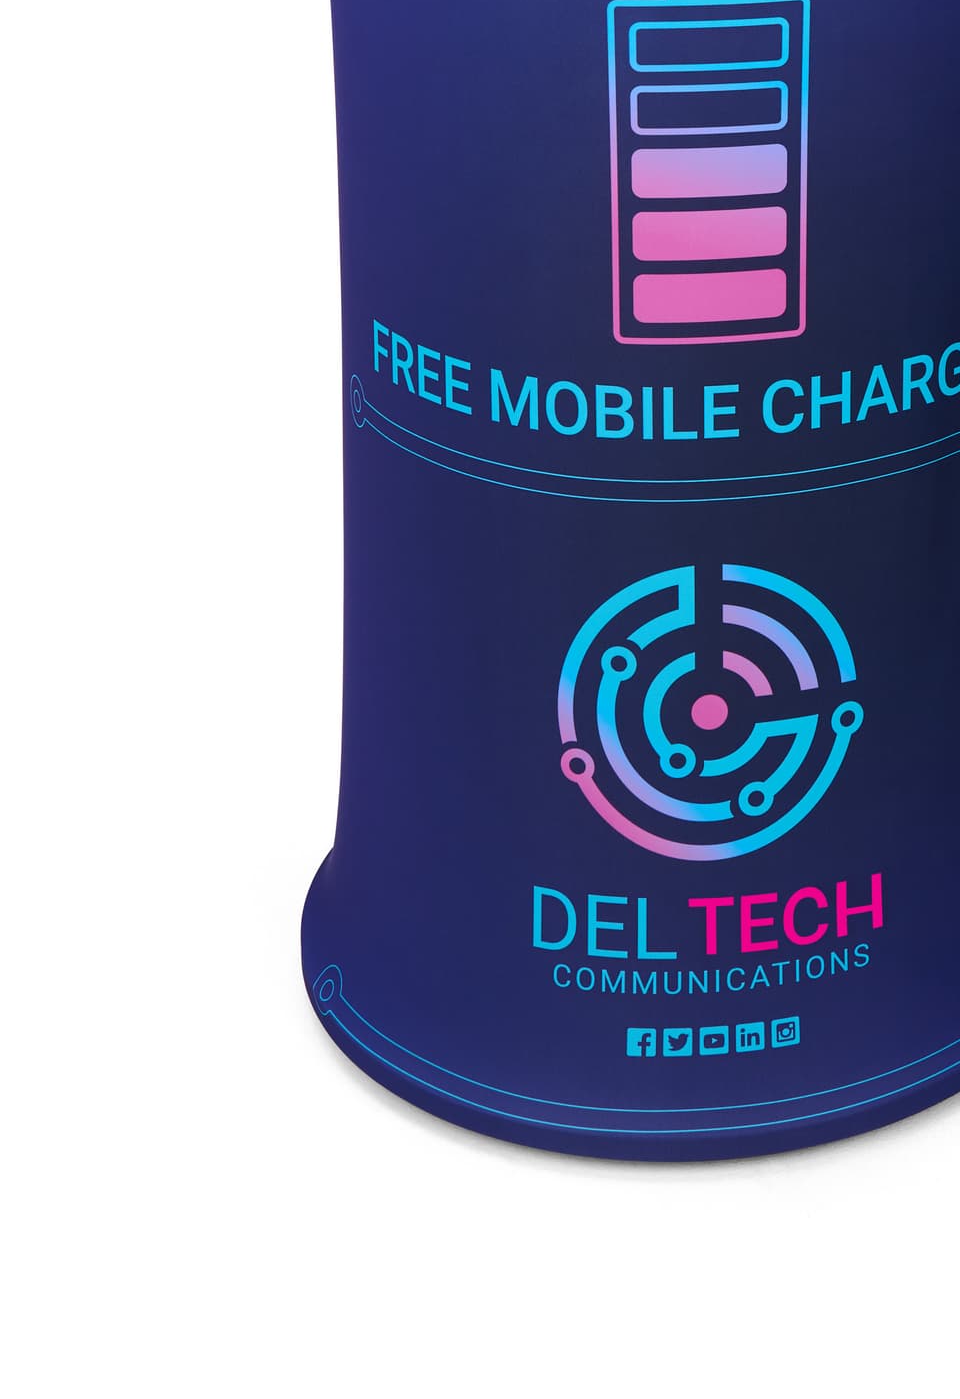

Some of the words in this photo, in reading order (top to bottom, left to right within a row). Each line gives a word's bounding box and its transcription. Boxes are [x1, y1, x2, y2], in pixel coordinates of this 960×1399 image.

[372, 318, 473, 416] FREE
[489, 367, 741, 441] MOBILE
[532, 884, 678, 961] DEL
[687, 872, 884, 956] TECH
[552, 942, 871, 996] COMMUNICATIONS
